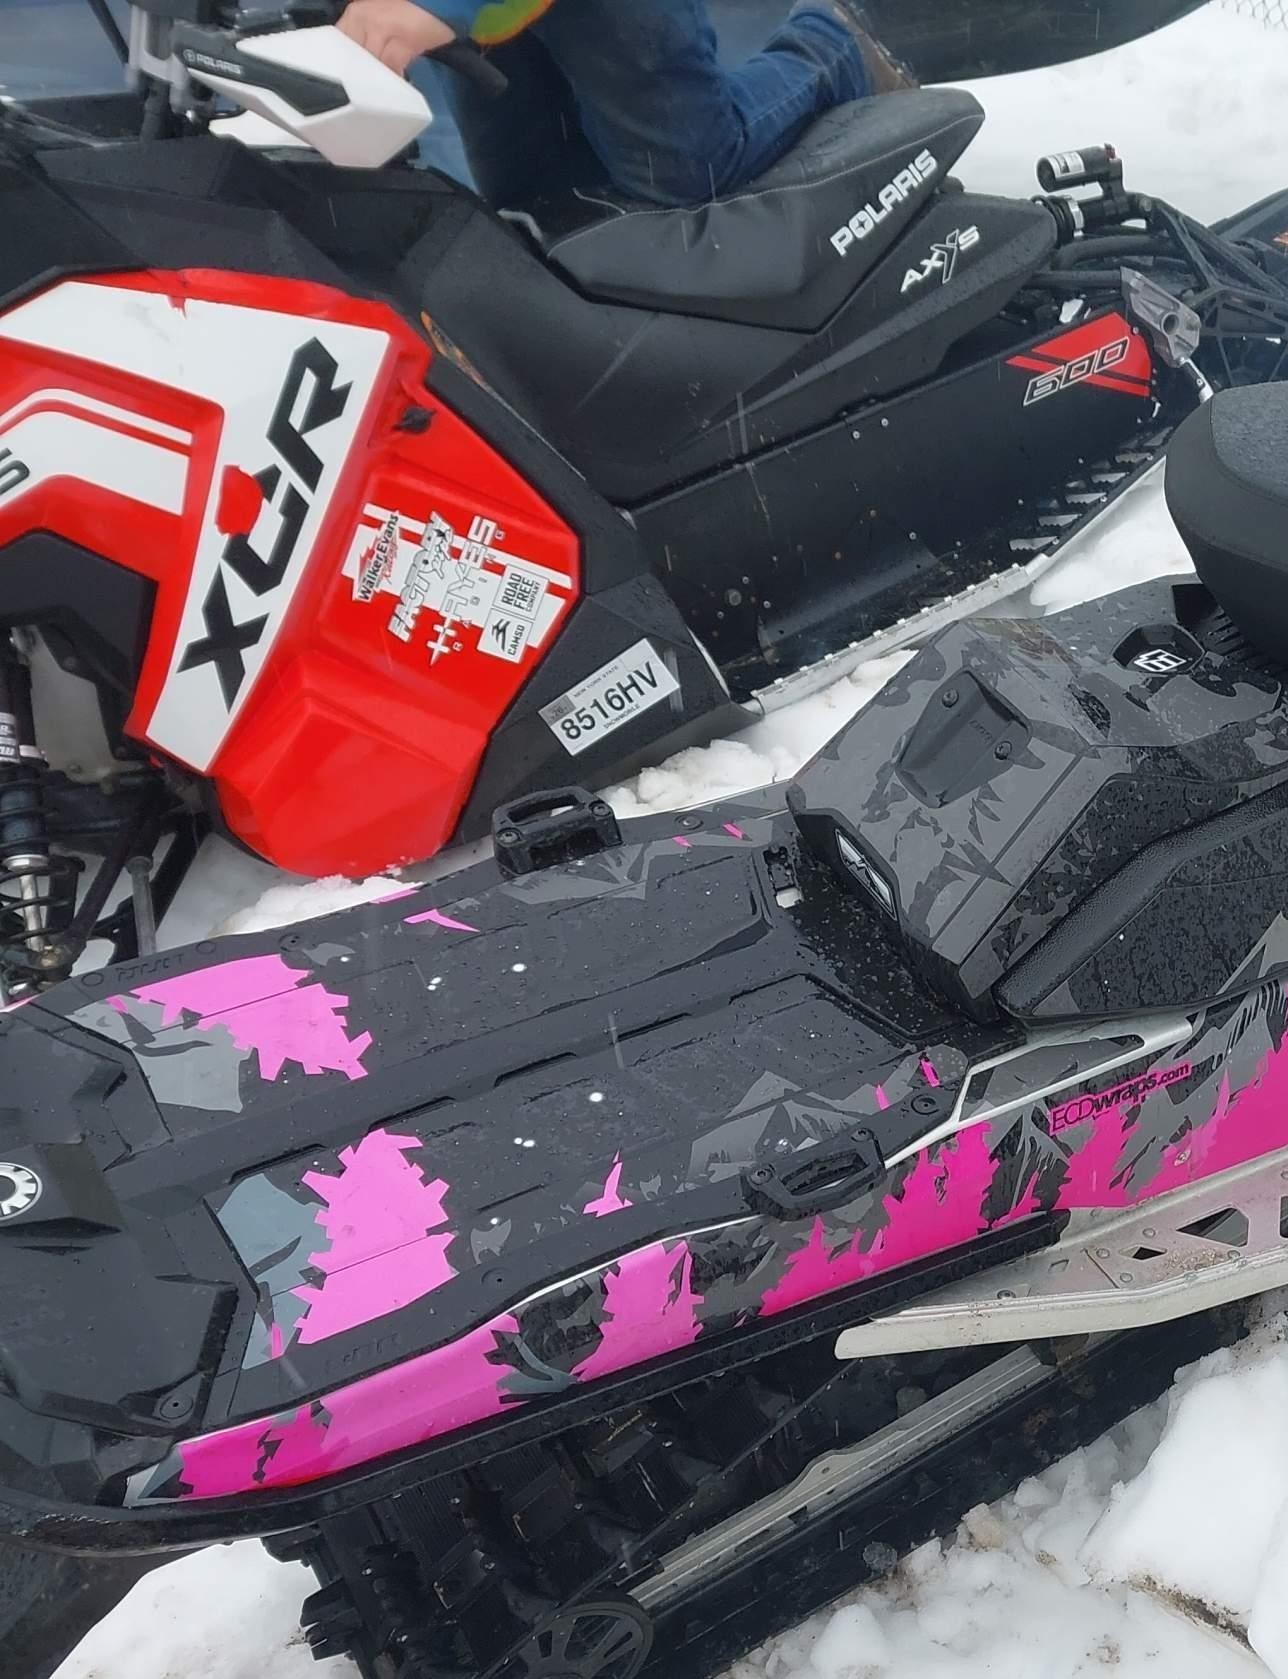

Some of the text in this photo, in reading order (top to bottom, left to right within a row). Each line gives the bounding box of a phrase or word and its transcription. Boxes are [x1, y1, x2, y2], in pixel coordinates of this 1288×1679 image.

[195, 52, 242, 75] POLARIS
[829, 148, 938, 257] POLARIS
[900, 225, 981, 293] AXYS
[1023, 336, 1130, 407] 600
[175, 336, 353, 714] XCR
[358, 513, 399, 601] Walker Evans
[388, 511, 454, 642] FACTORY
[502, 572, 523, 606] ROAD
[514, 577, 535, 610] FREE
[525, 582, 542, 612] COMPANY
[507, 624, 526, 656] CAMSO
[560, 661, 658, 740] 8516HV
